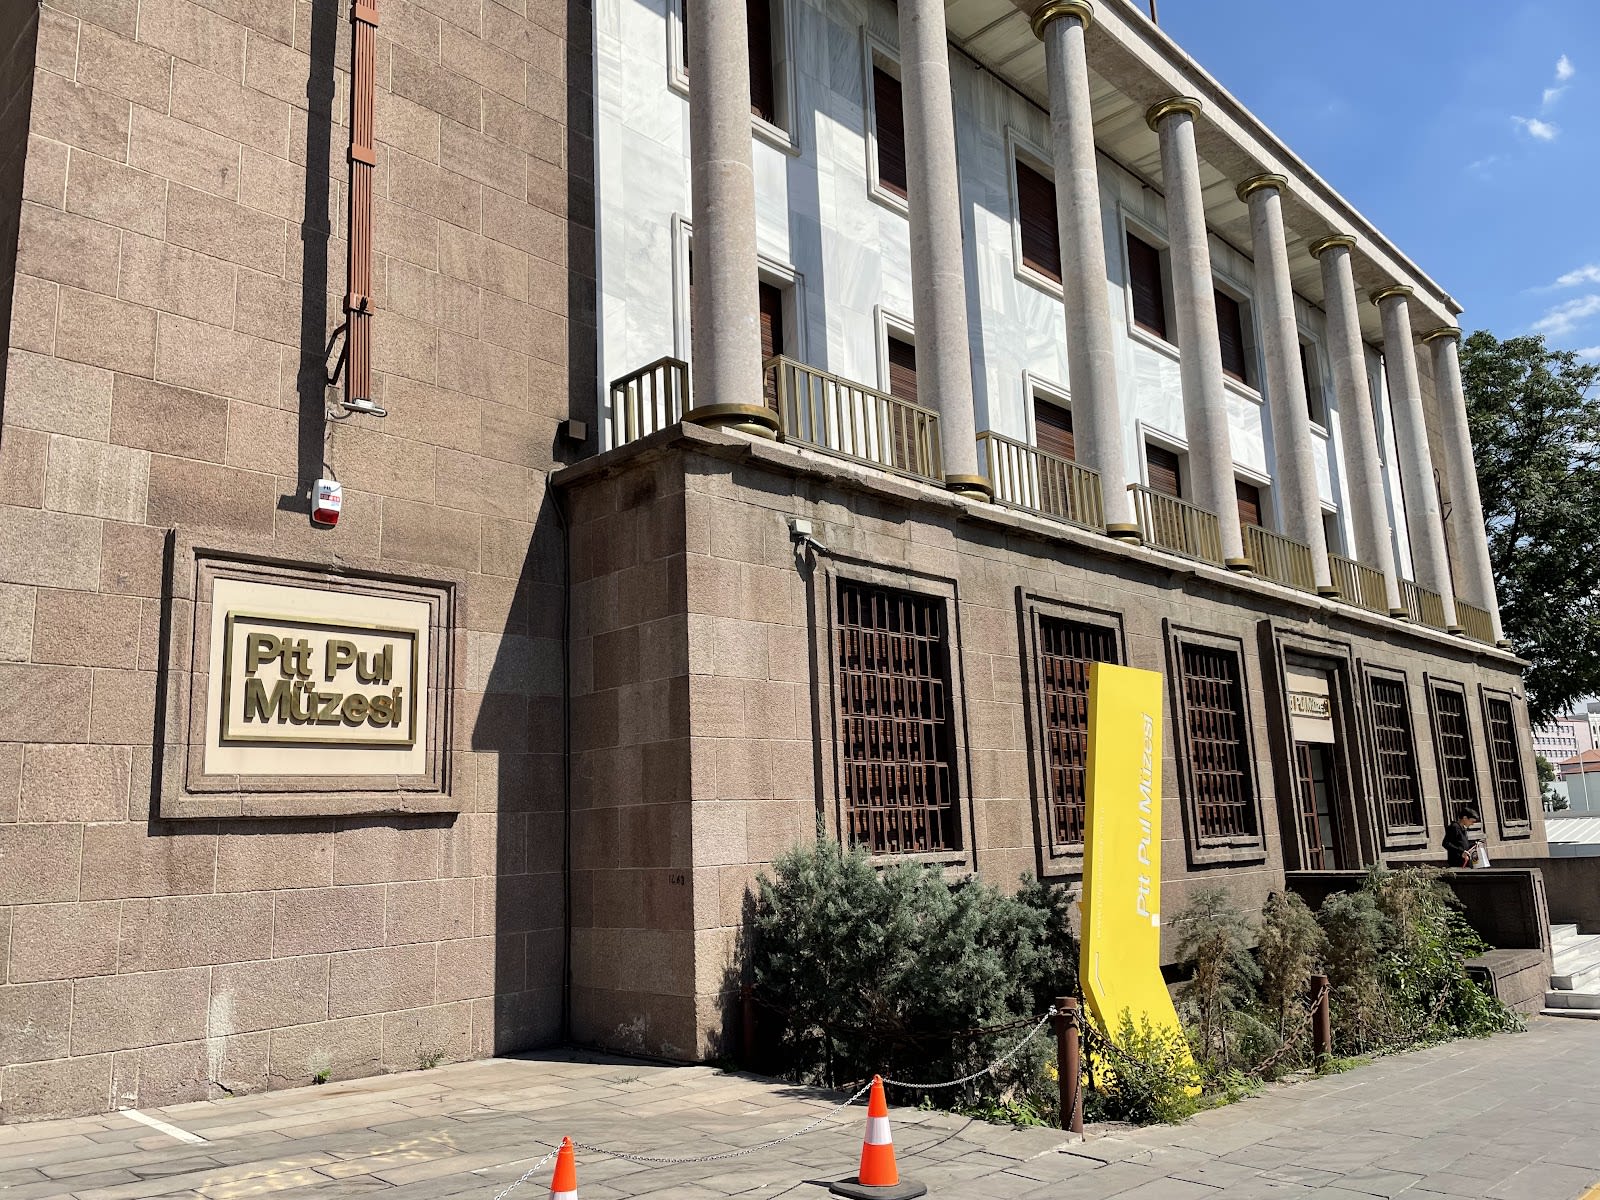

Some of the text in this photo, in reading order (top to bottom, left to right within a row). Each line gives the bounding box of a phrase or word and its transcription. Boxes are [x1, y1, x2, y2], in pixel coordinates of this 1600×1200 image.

[246, 633, 393, 684] Ptt Pul
[244, 678, 402, 726] Müzesi
[1136, 712, 1153, 918] Ptt Pul Müzesi
